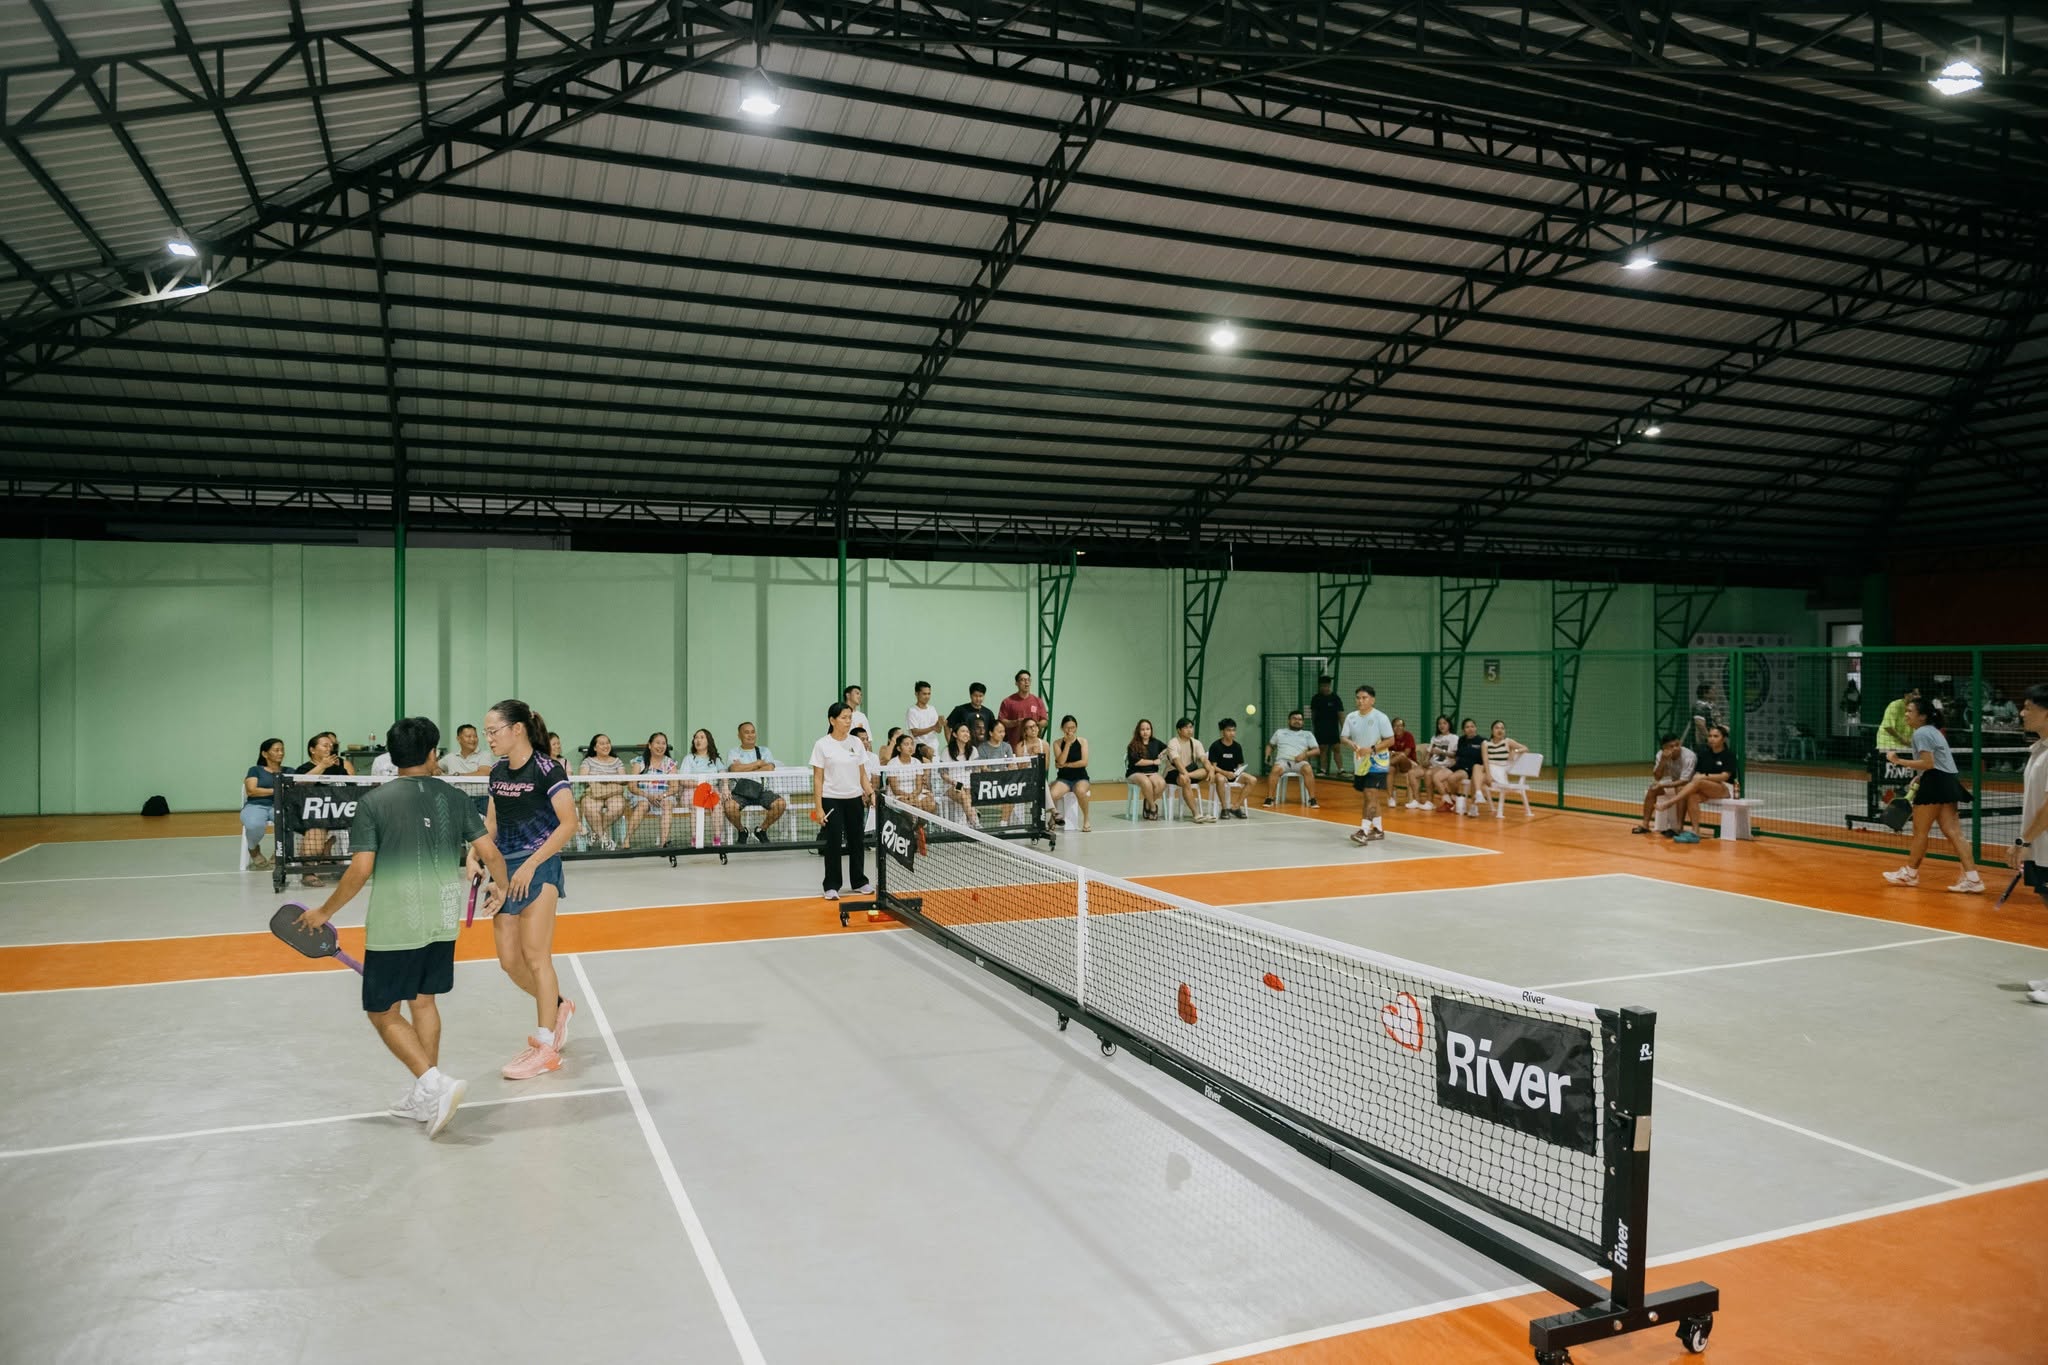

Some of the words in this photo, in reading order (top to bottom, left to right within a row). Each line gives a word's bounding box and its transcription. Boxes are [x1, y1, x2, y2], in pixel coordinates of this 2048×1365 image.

[1488, 665, 1497, 681] 5
[978, 780, 1027, 801] River
[302, 796, 358, 820] Rive
[881, 820, 911, 857] River
[1522, 990, 1546, 1005] River
[1447, 1030, 1572, 1114] River
[1614, 1217, 1629, 1270] River
